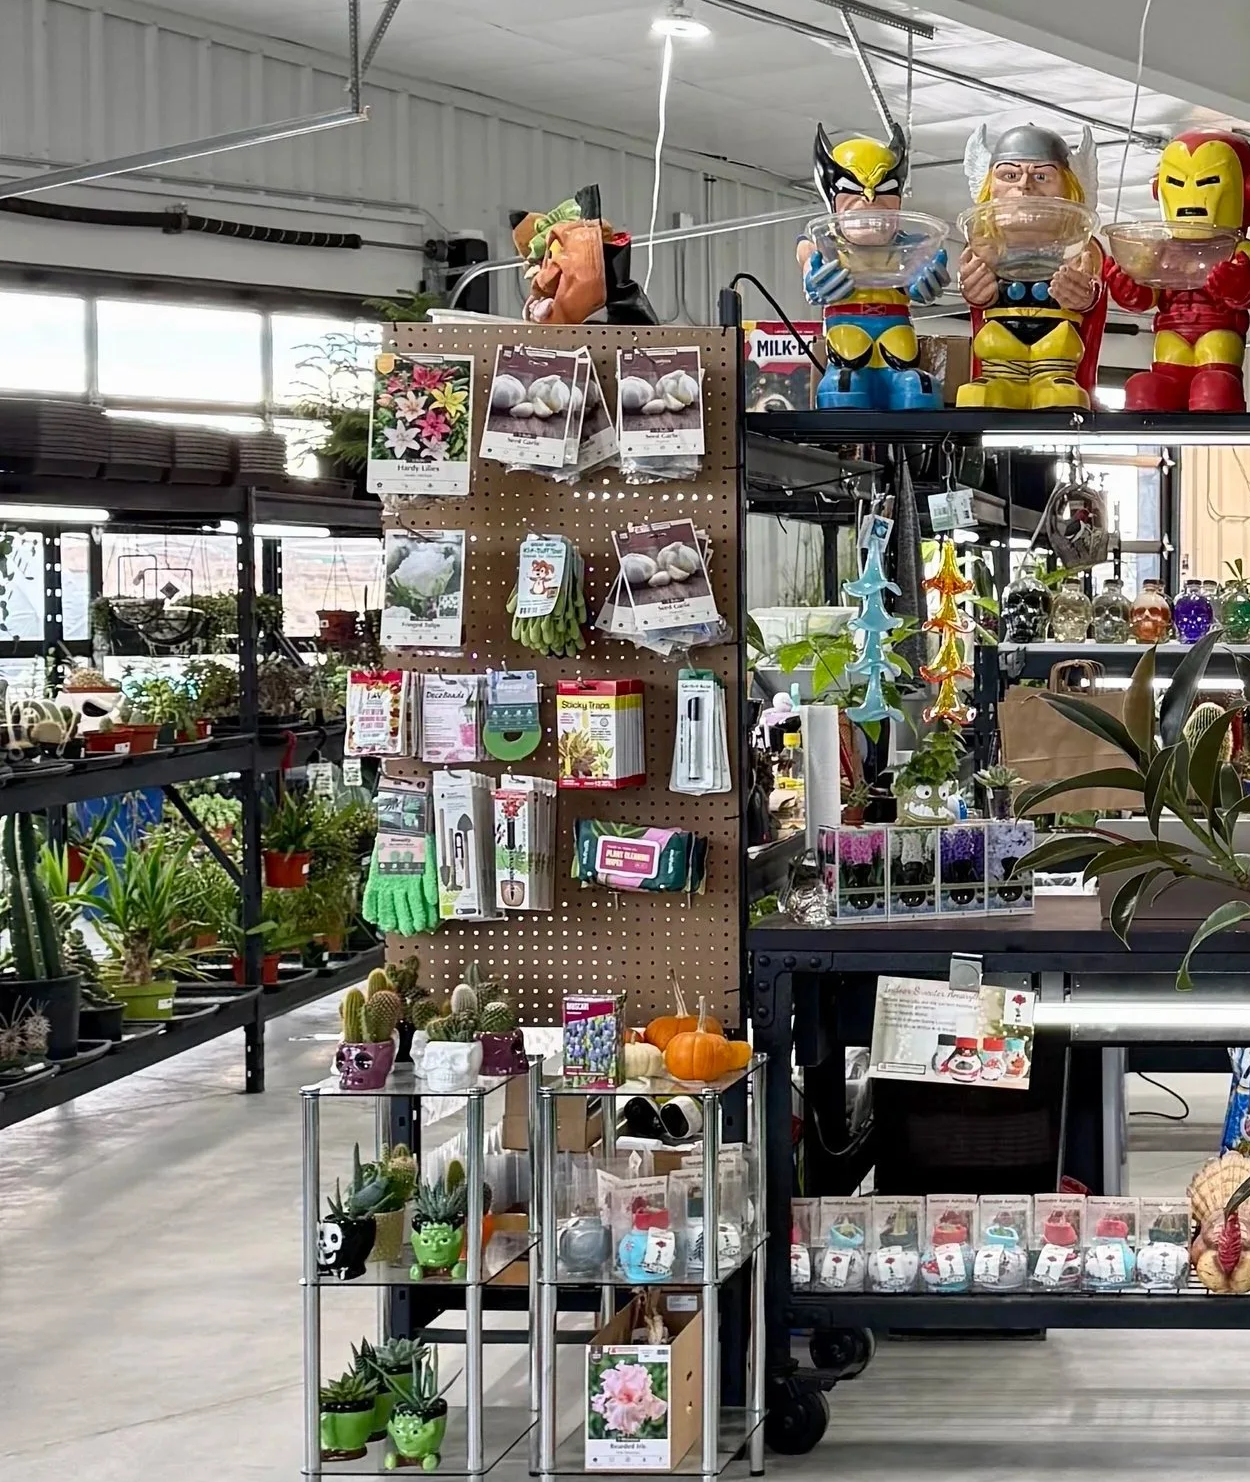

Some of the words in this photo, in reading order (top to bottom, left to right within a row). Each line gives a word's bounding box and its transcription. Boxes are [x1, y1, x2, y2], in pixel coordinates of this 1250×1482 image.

[397, 464, 419, 472] Hardy
[561, 700, 588, 711] Sticky
[588, 701, 611, 709] Traps
[606, 849, 624, 859] PLANT
